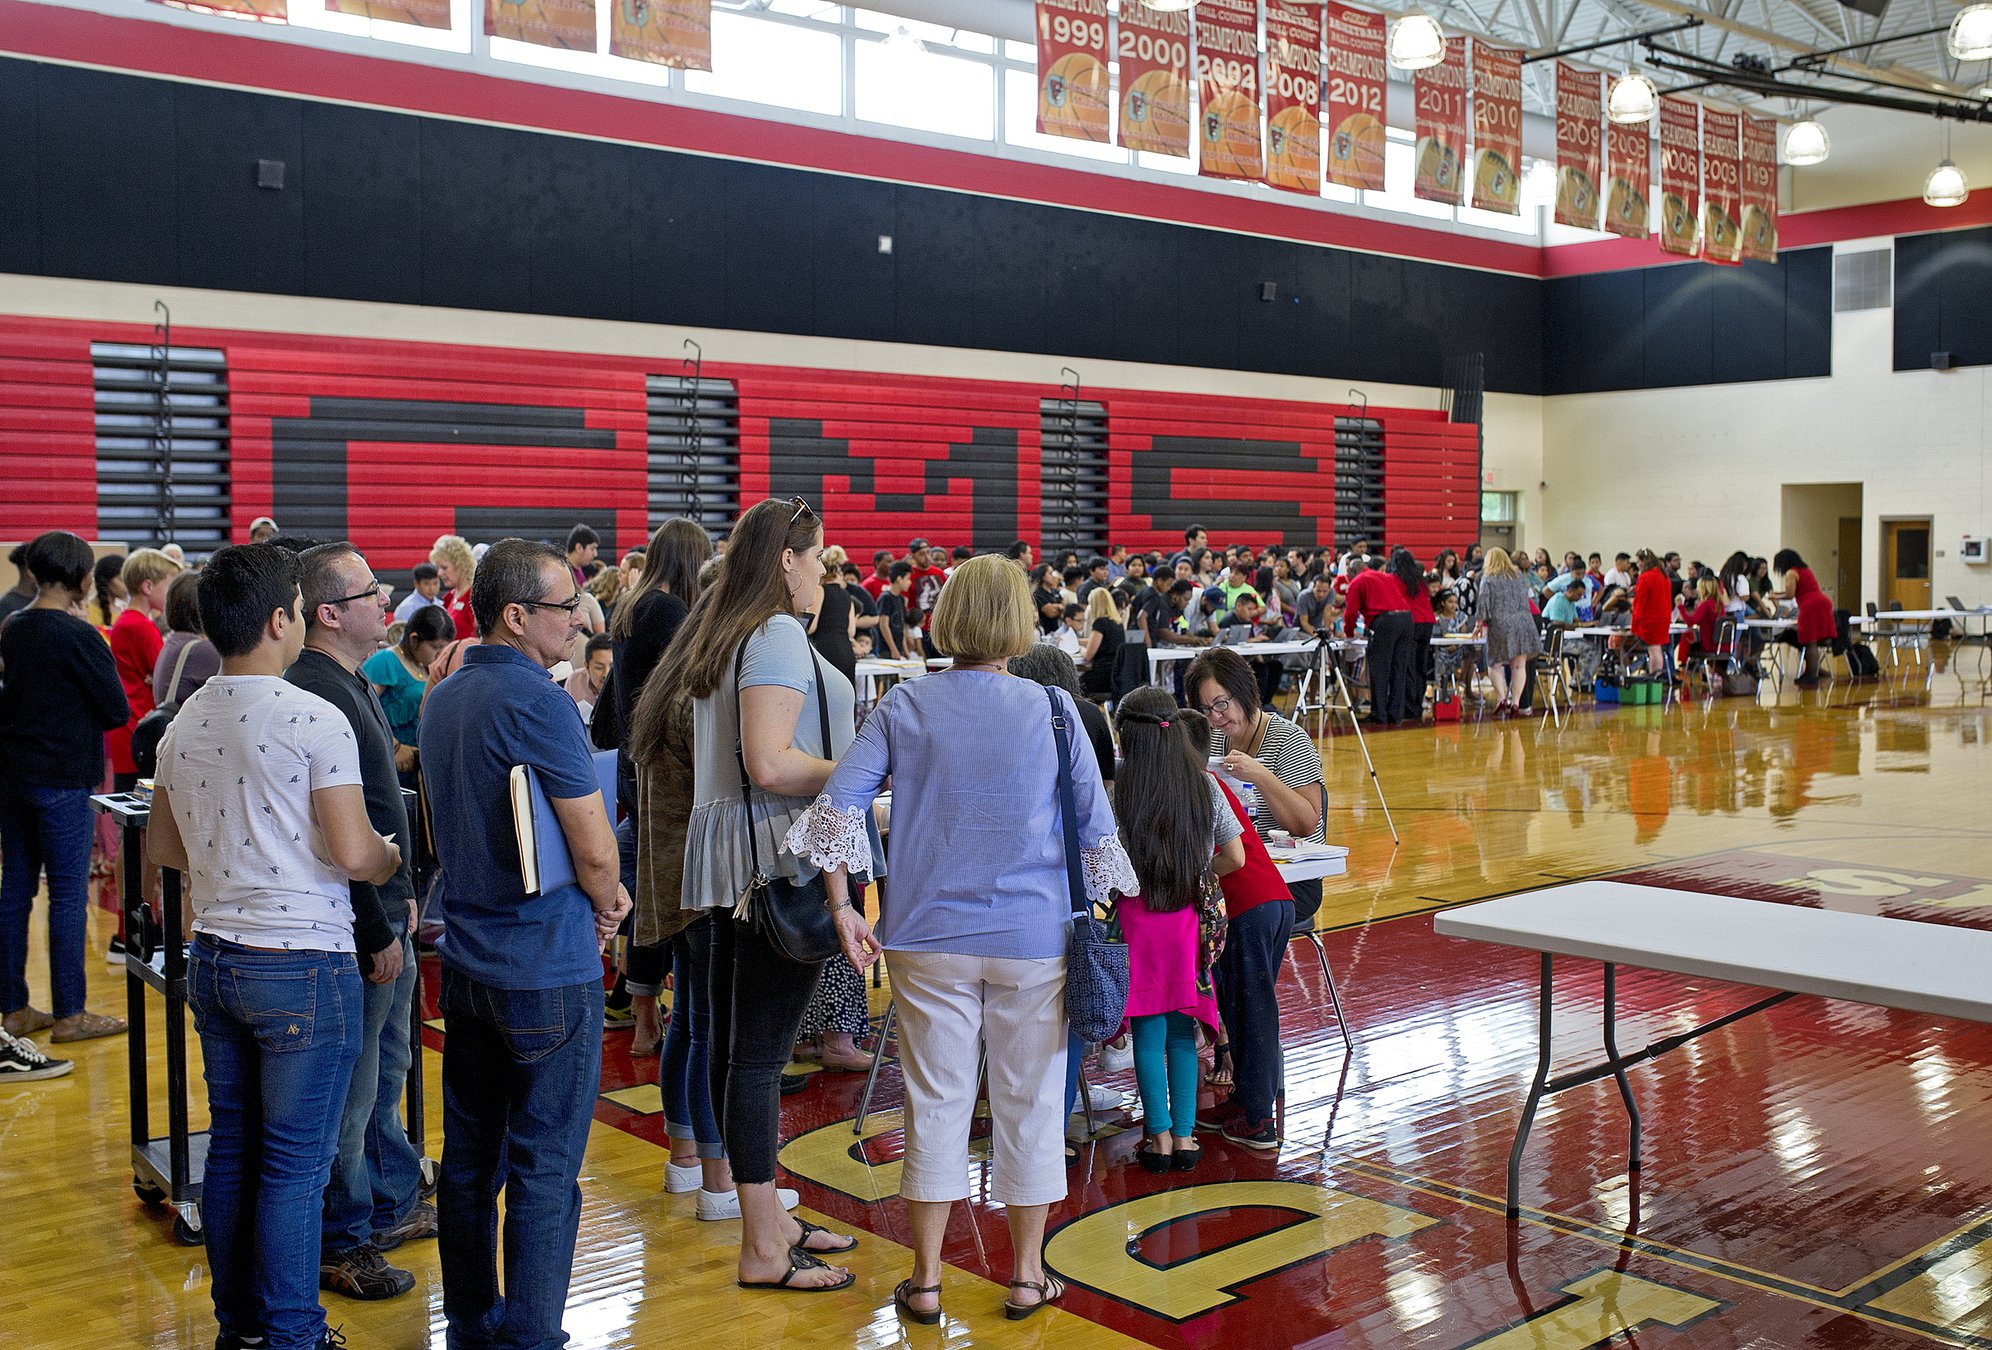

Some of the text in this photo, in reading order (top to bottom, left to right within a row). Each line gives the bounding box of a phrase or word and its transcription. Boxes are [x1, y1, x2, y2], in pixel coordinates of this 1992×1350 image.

[1040, 12, 1105, 50] 1999
[1196, 21, 1257, 59] CHAMPIONS
[1119, 30, 1187, 69] 2000
[1328, 46, 1385, 83] CHAMPIONS
[1198, 54, 1256, 90] 2002
[1266, 60, 1319, 106] 2008
[1329, 77, 1383, 112] 2012
[1419, 86, 1462, 117] 2011
[1475, 98, 1519, 129] 2010
[1557, 118, 1600, 149] 2009
